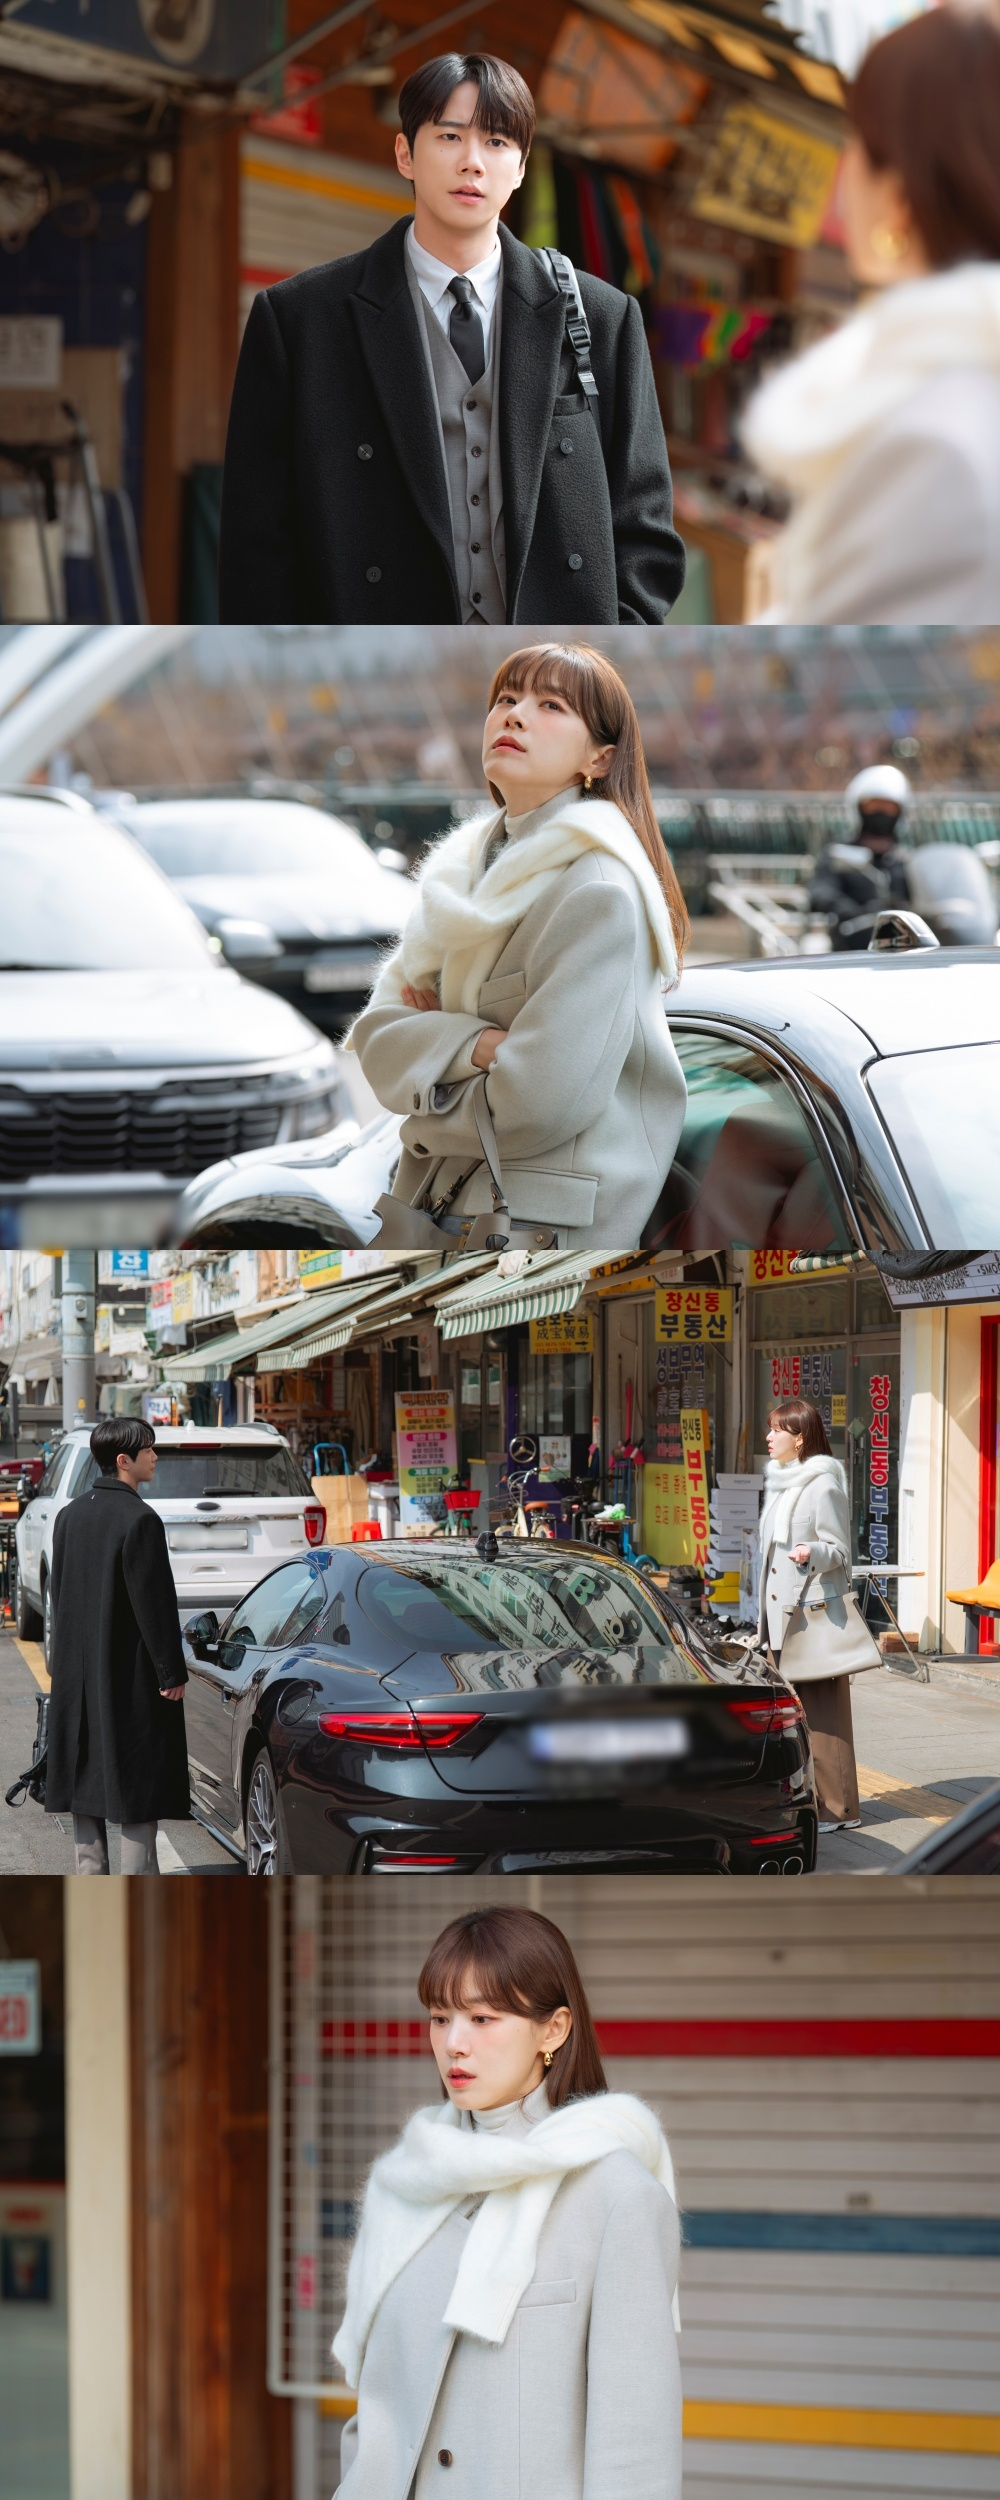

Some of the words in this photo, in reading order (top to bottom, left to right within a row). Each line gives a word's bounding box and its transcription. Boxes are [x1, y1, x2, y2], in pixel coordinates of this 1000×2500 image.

[944, 1277, 967, 1289] SUGAR
[666, 1292, 719, 1313] 창신동
[920, 1290, 946, 1302] MATCHA
[660, 1314, 727, 1339] 부동산
[656, 1343, 705, 1385] 성보무역
[682, 1418, 702, 1441] 창신동
